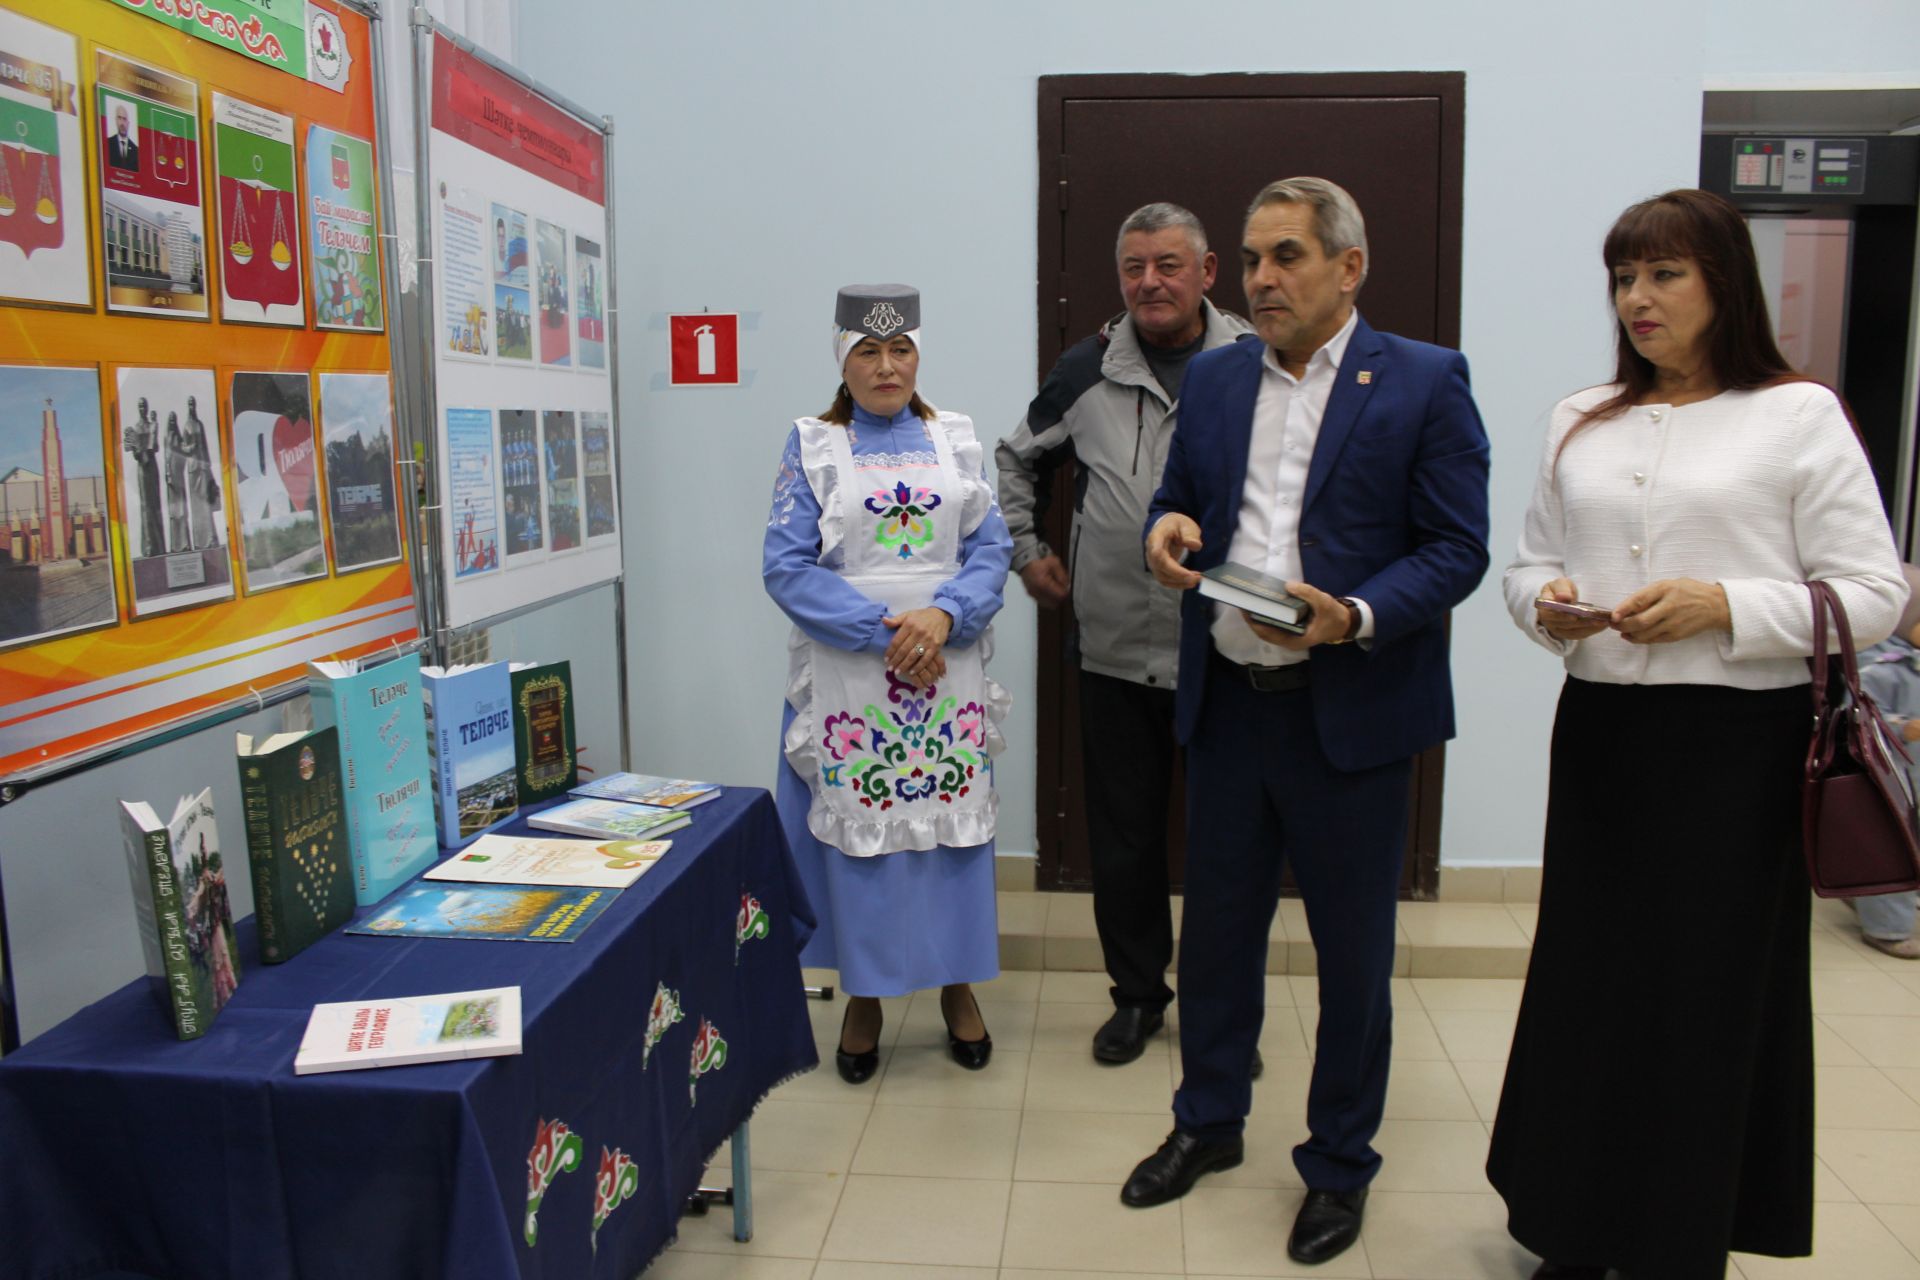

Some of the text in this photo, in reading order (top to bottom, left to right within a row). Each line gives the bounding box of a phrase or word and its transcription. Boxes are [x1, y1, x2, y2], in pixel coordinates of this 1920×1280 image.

[369, 680, 408, 708] Теләче
[459, 710, 509, 746] ТЕЛӘЧЕ
[172, 973, 198, 1034] ТУГАН
